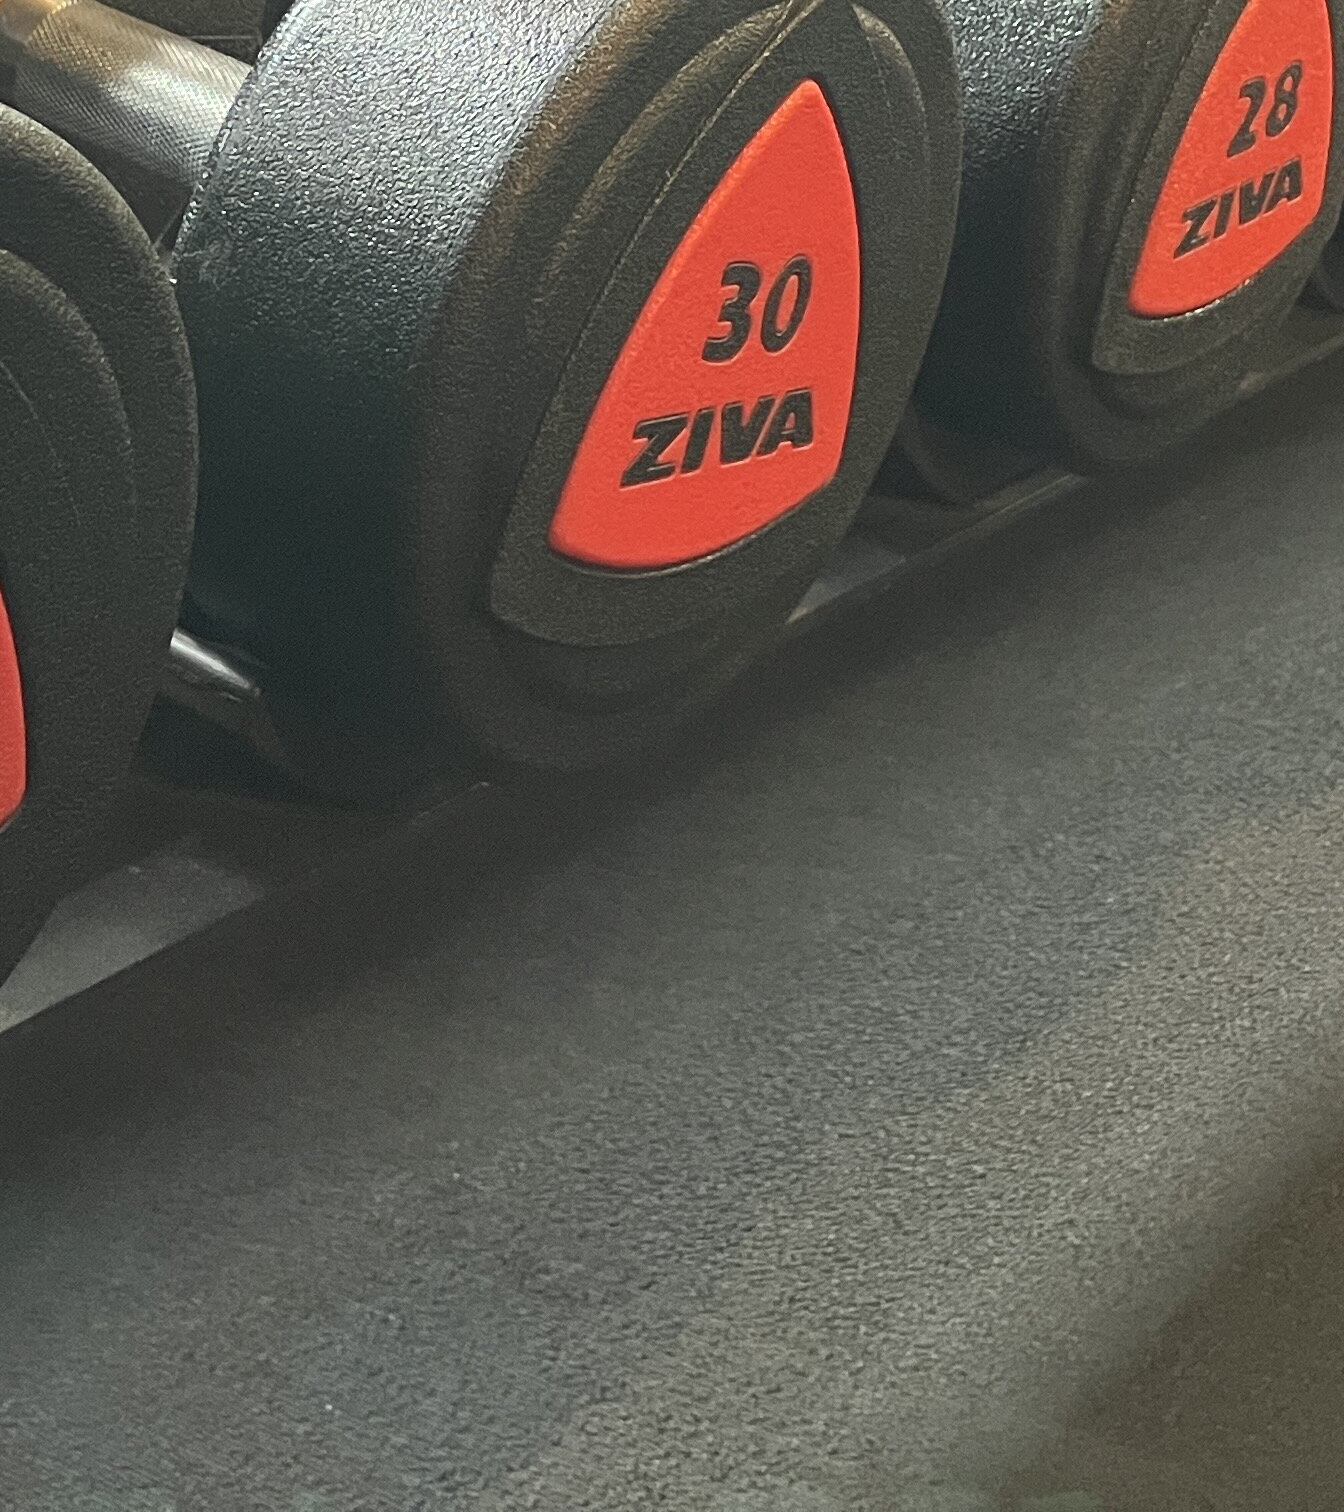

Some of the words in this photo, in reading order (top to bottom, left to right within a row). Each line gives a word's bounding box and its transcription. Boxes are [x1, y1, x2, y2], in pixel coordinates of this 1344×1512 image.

[1226, 63, 1303, 159] 28
[1172, 157, 1303, 260] ZIVA
[702, 253, 814, 364] 30
[619, 389, 815, 489] ZIVA
